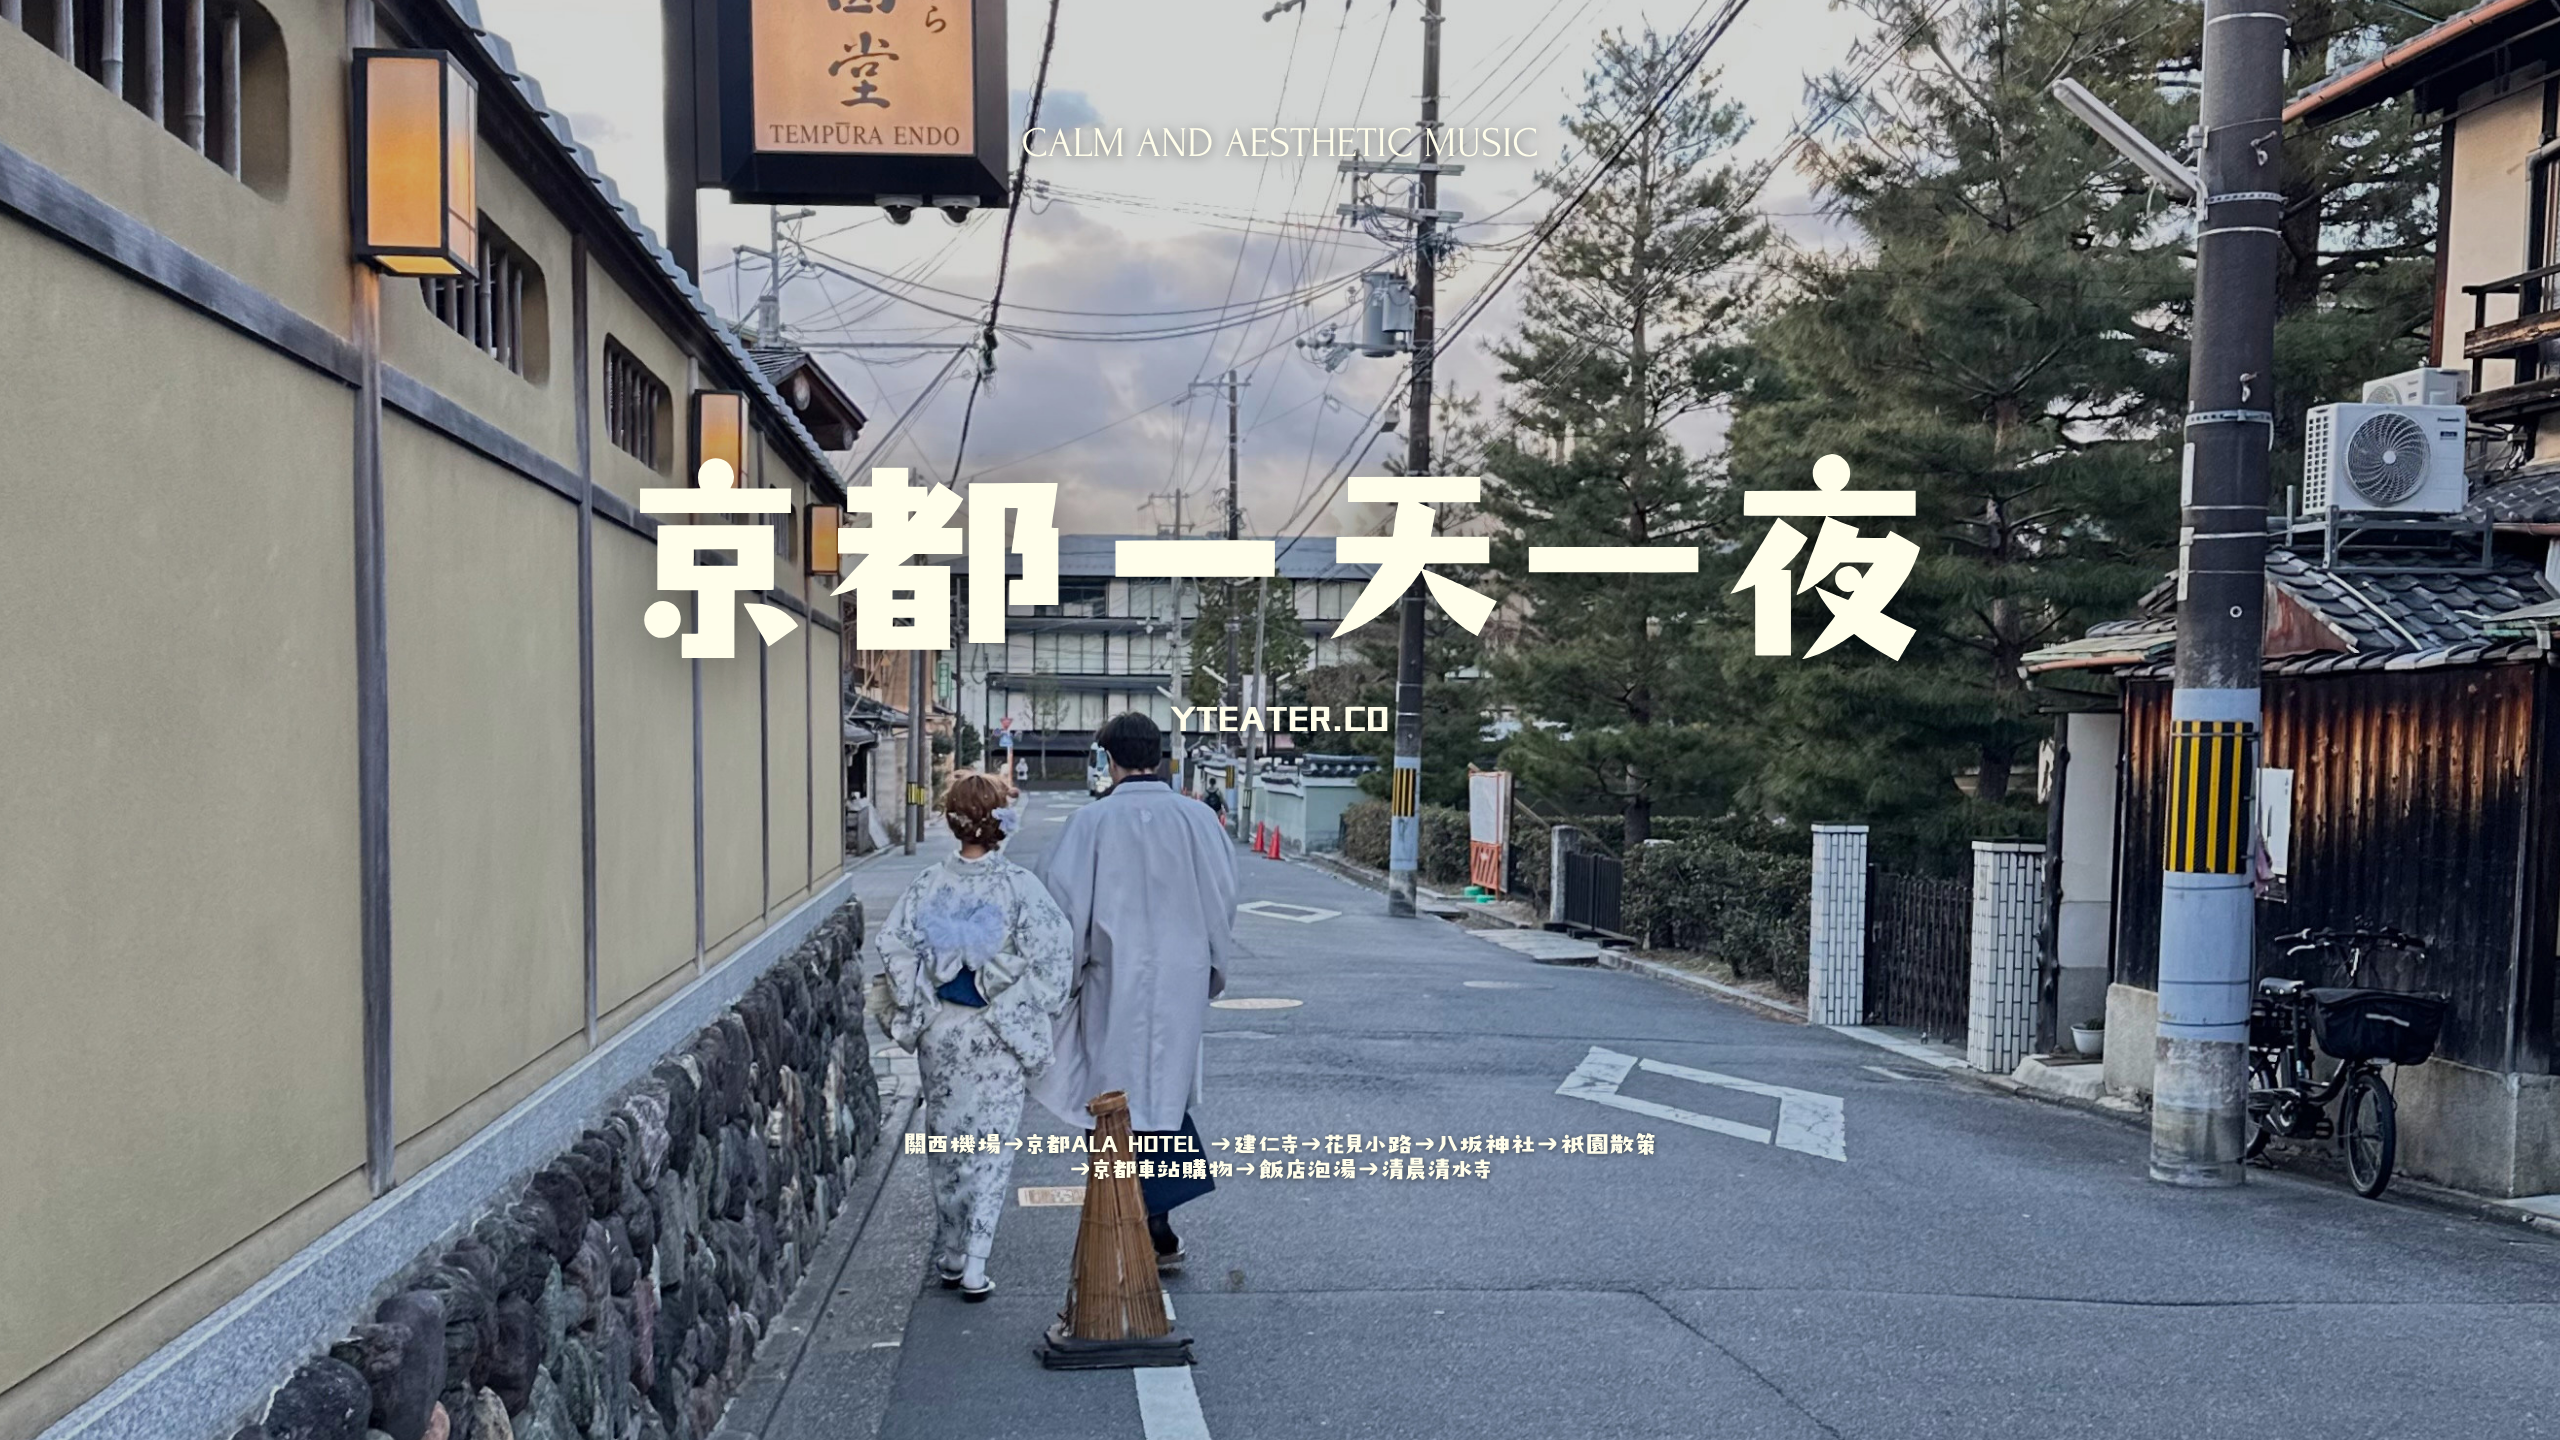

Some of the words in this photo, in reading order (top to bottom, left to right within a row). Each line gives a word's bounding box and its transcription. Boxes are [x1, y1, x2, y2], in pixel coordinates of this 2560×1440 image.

[925, 6, 947, 33] ら
[828, 0, 899, 109] 堂
[894, 126, 960, 146] ENDO
